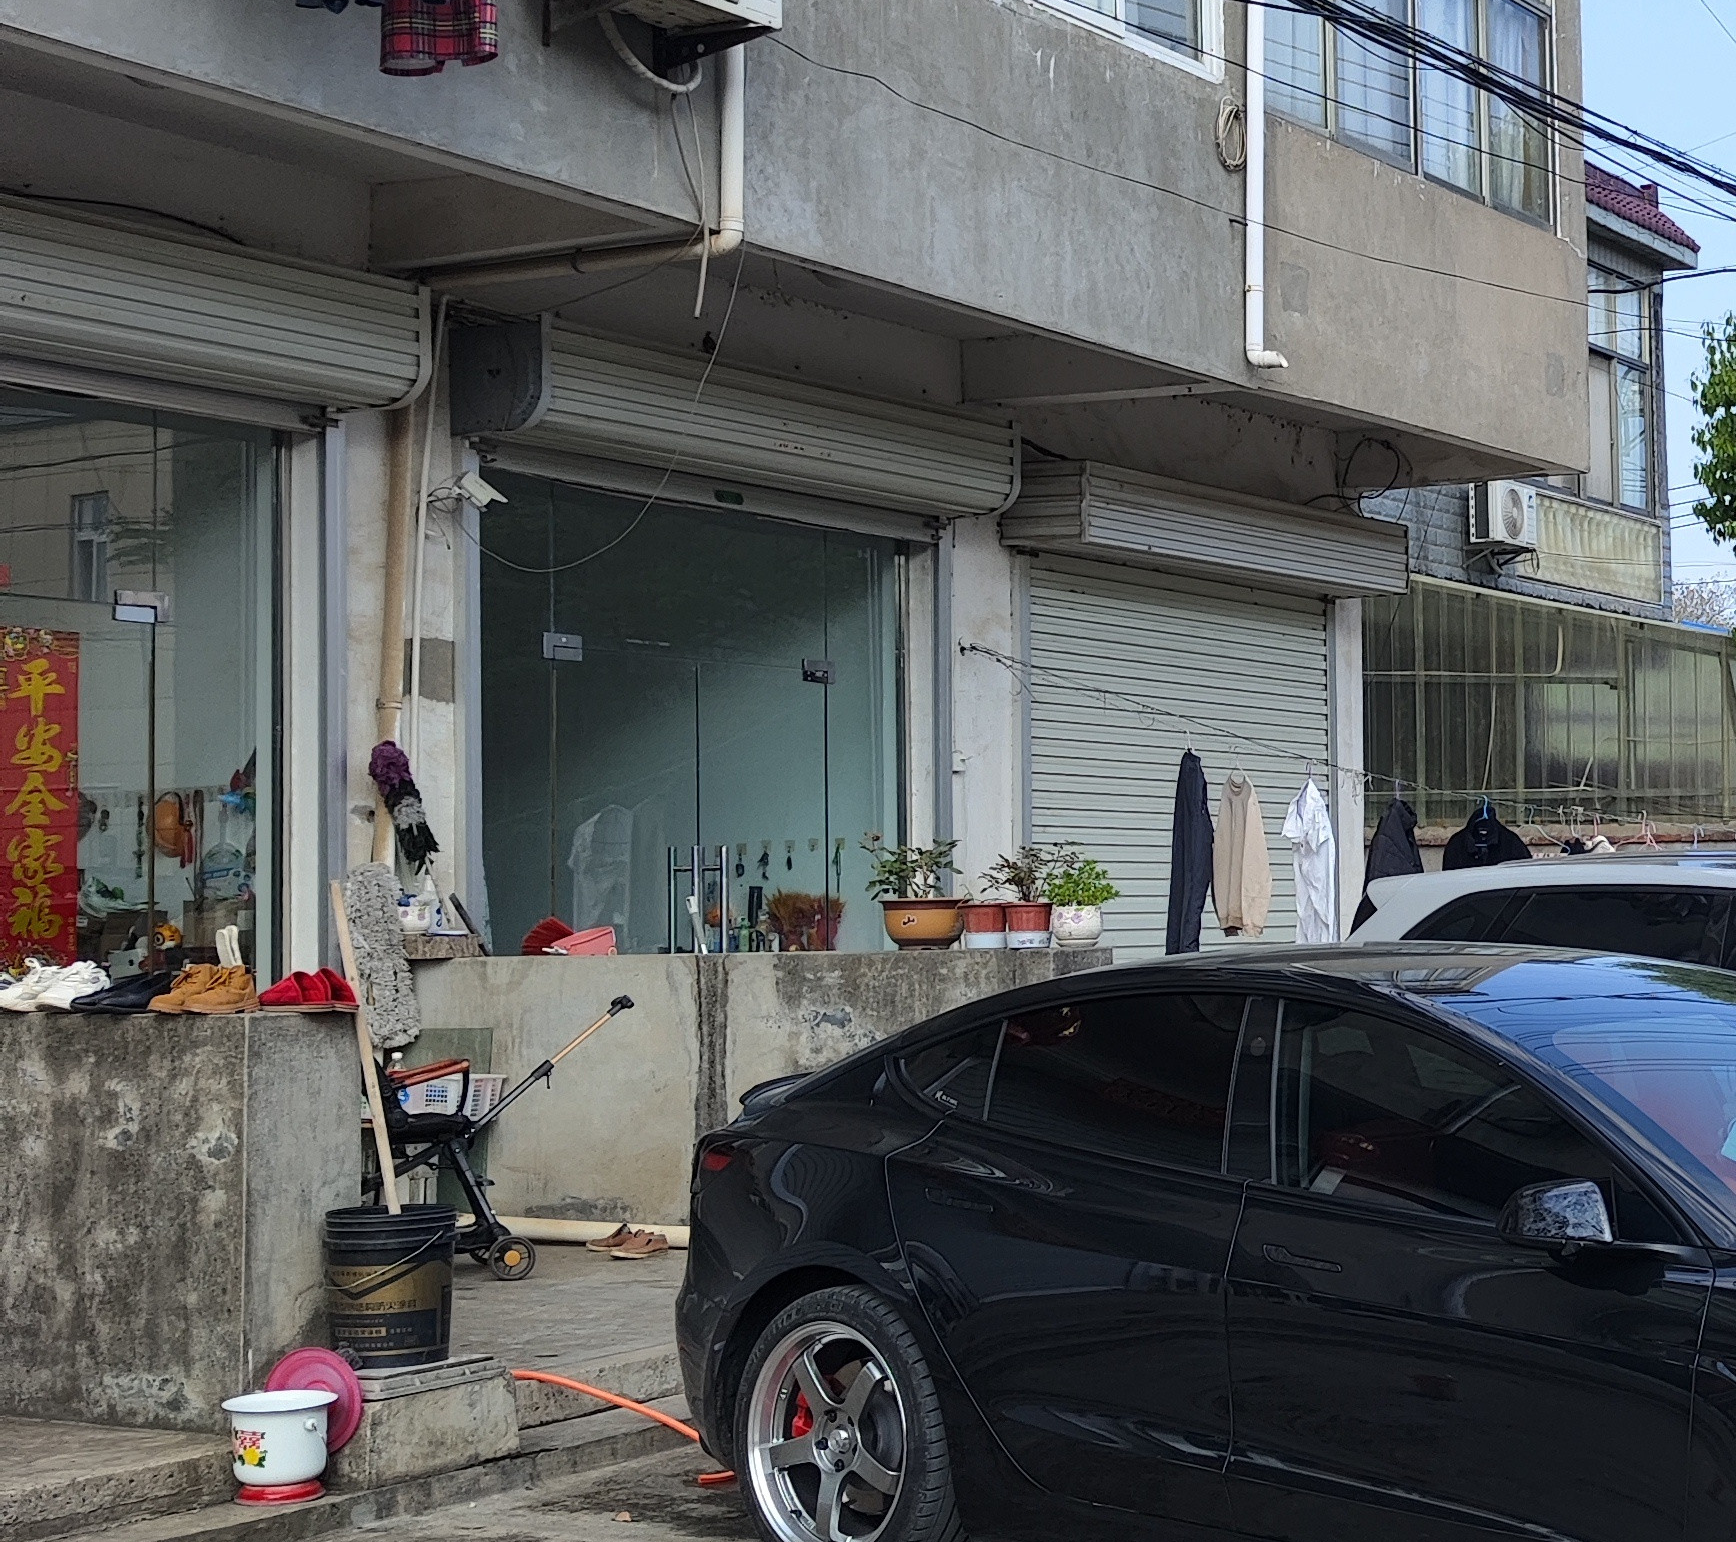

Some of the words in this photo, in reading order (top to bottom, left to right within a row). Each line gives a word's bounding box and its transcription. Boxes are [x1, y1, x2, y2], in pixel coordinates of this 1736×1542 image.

[7, 658, 68, 939] 平安全家福
